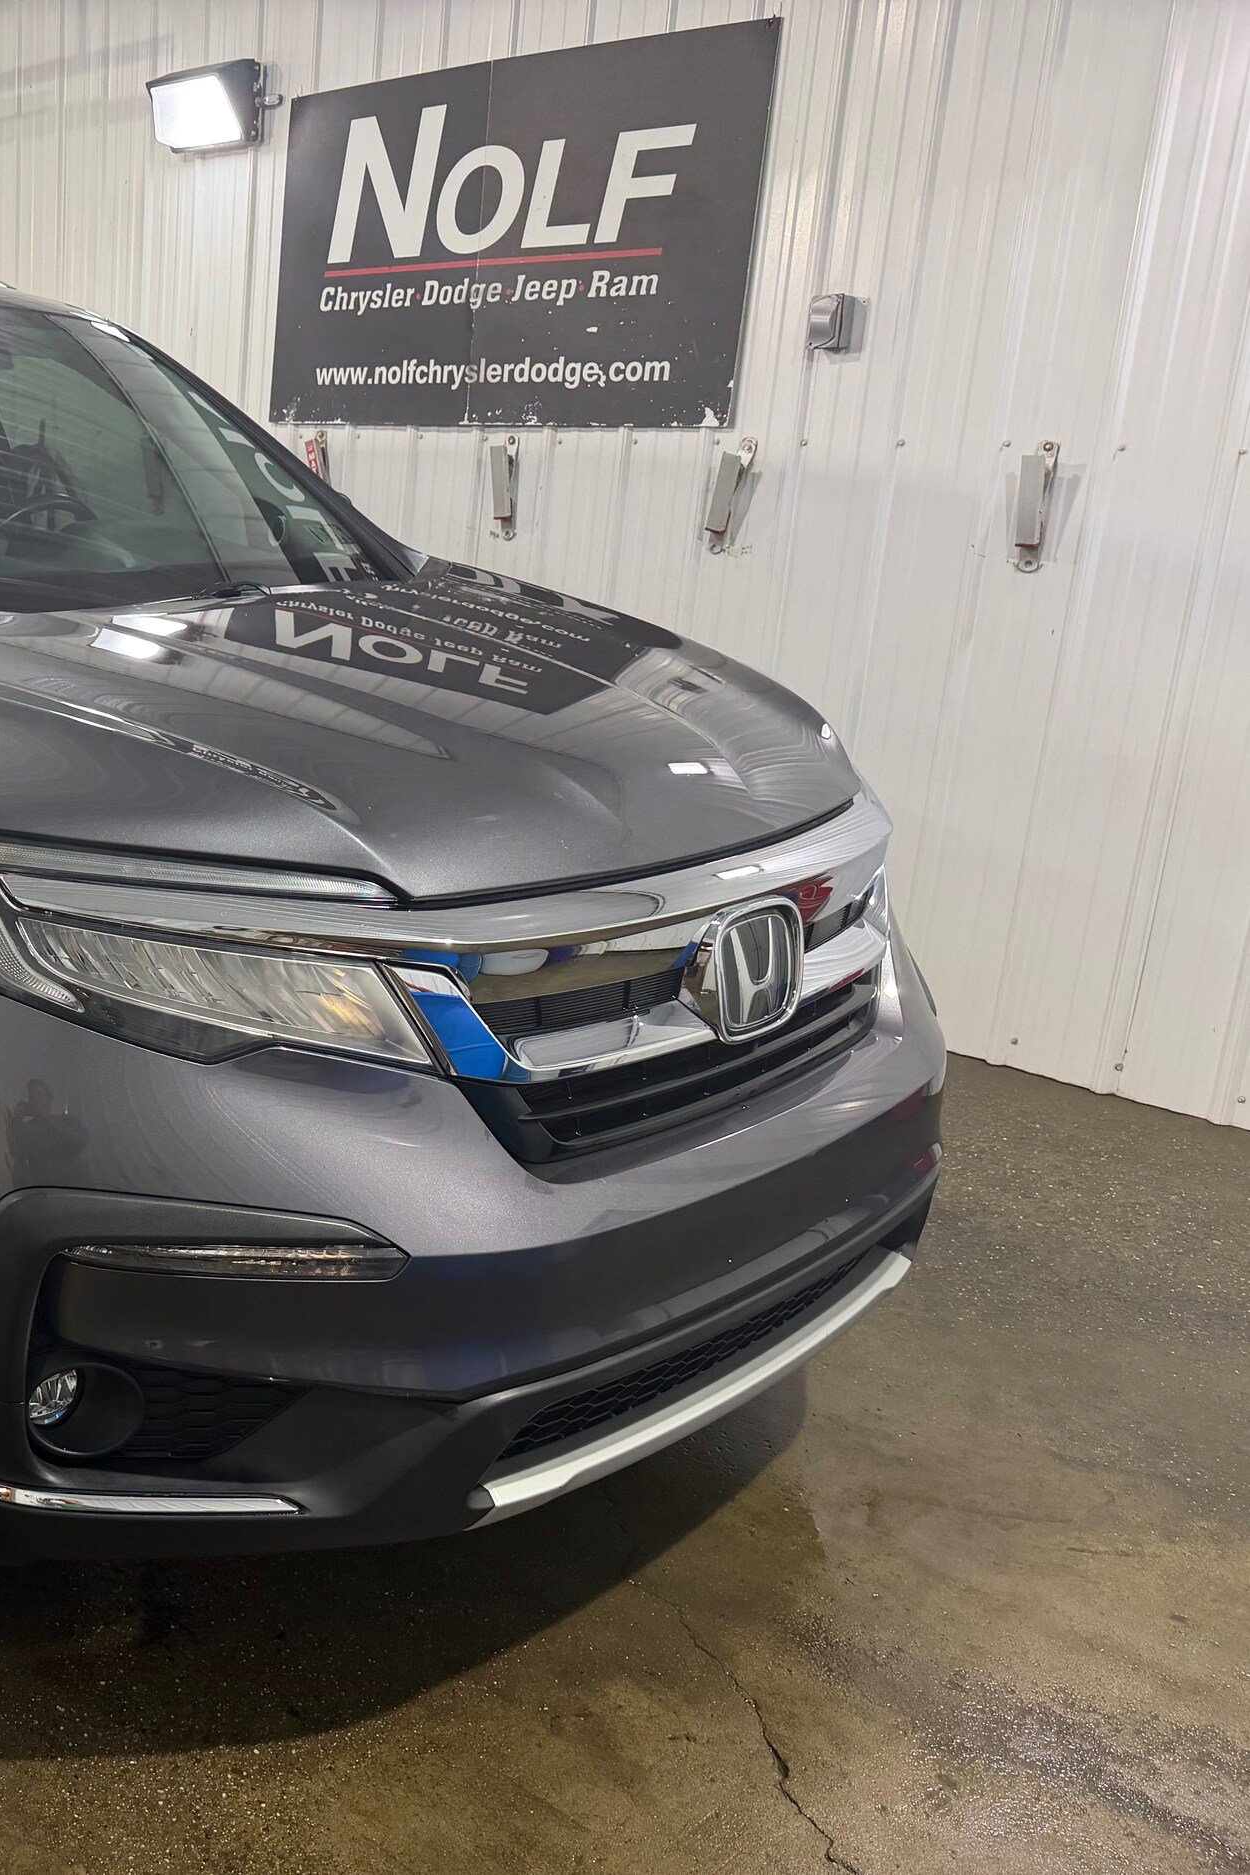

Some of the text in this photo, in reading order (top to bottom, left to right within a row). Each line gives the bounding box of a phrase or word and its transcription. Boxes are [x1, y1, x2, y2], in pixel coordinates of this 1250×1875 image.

[327, 104, 697, 264] NOLF
[319, 270, 659, 316] Chrysler Dodge Jeep Ram
[316, 356, 671, 390] www.nolfchryslerdodge.com
